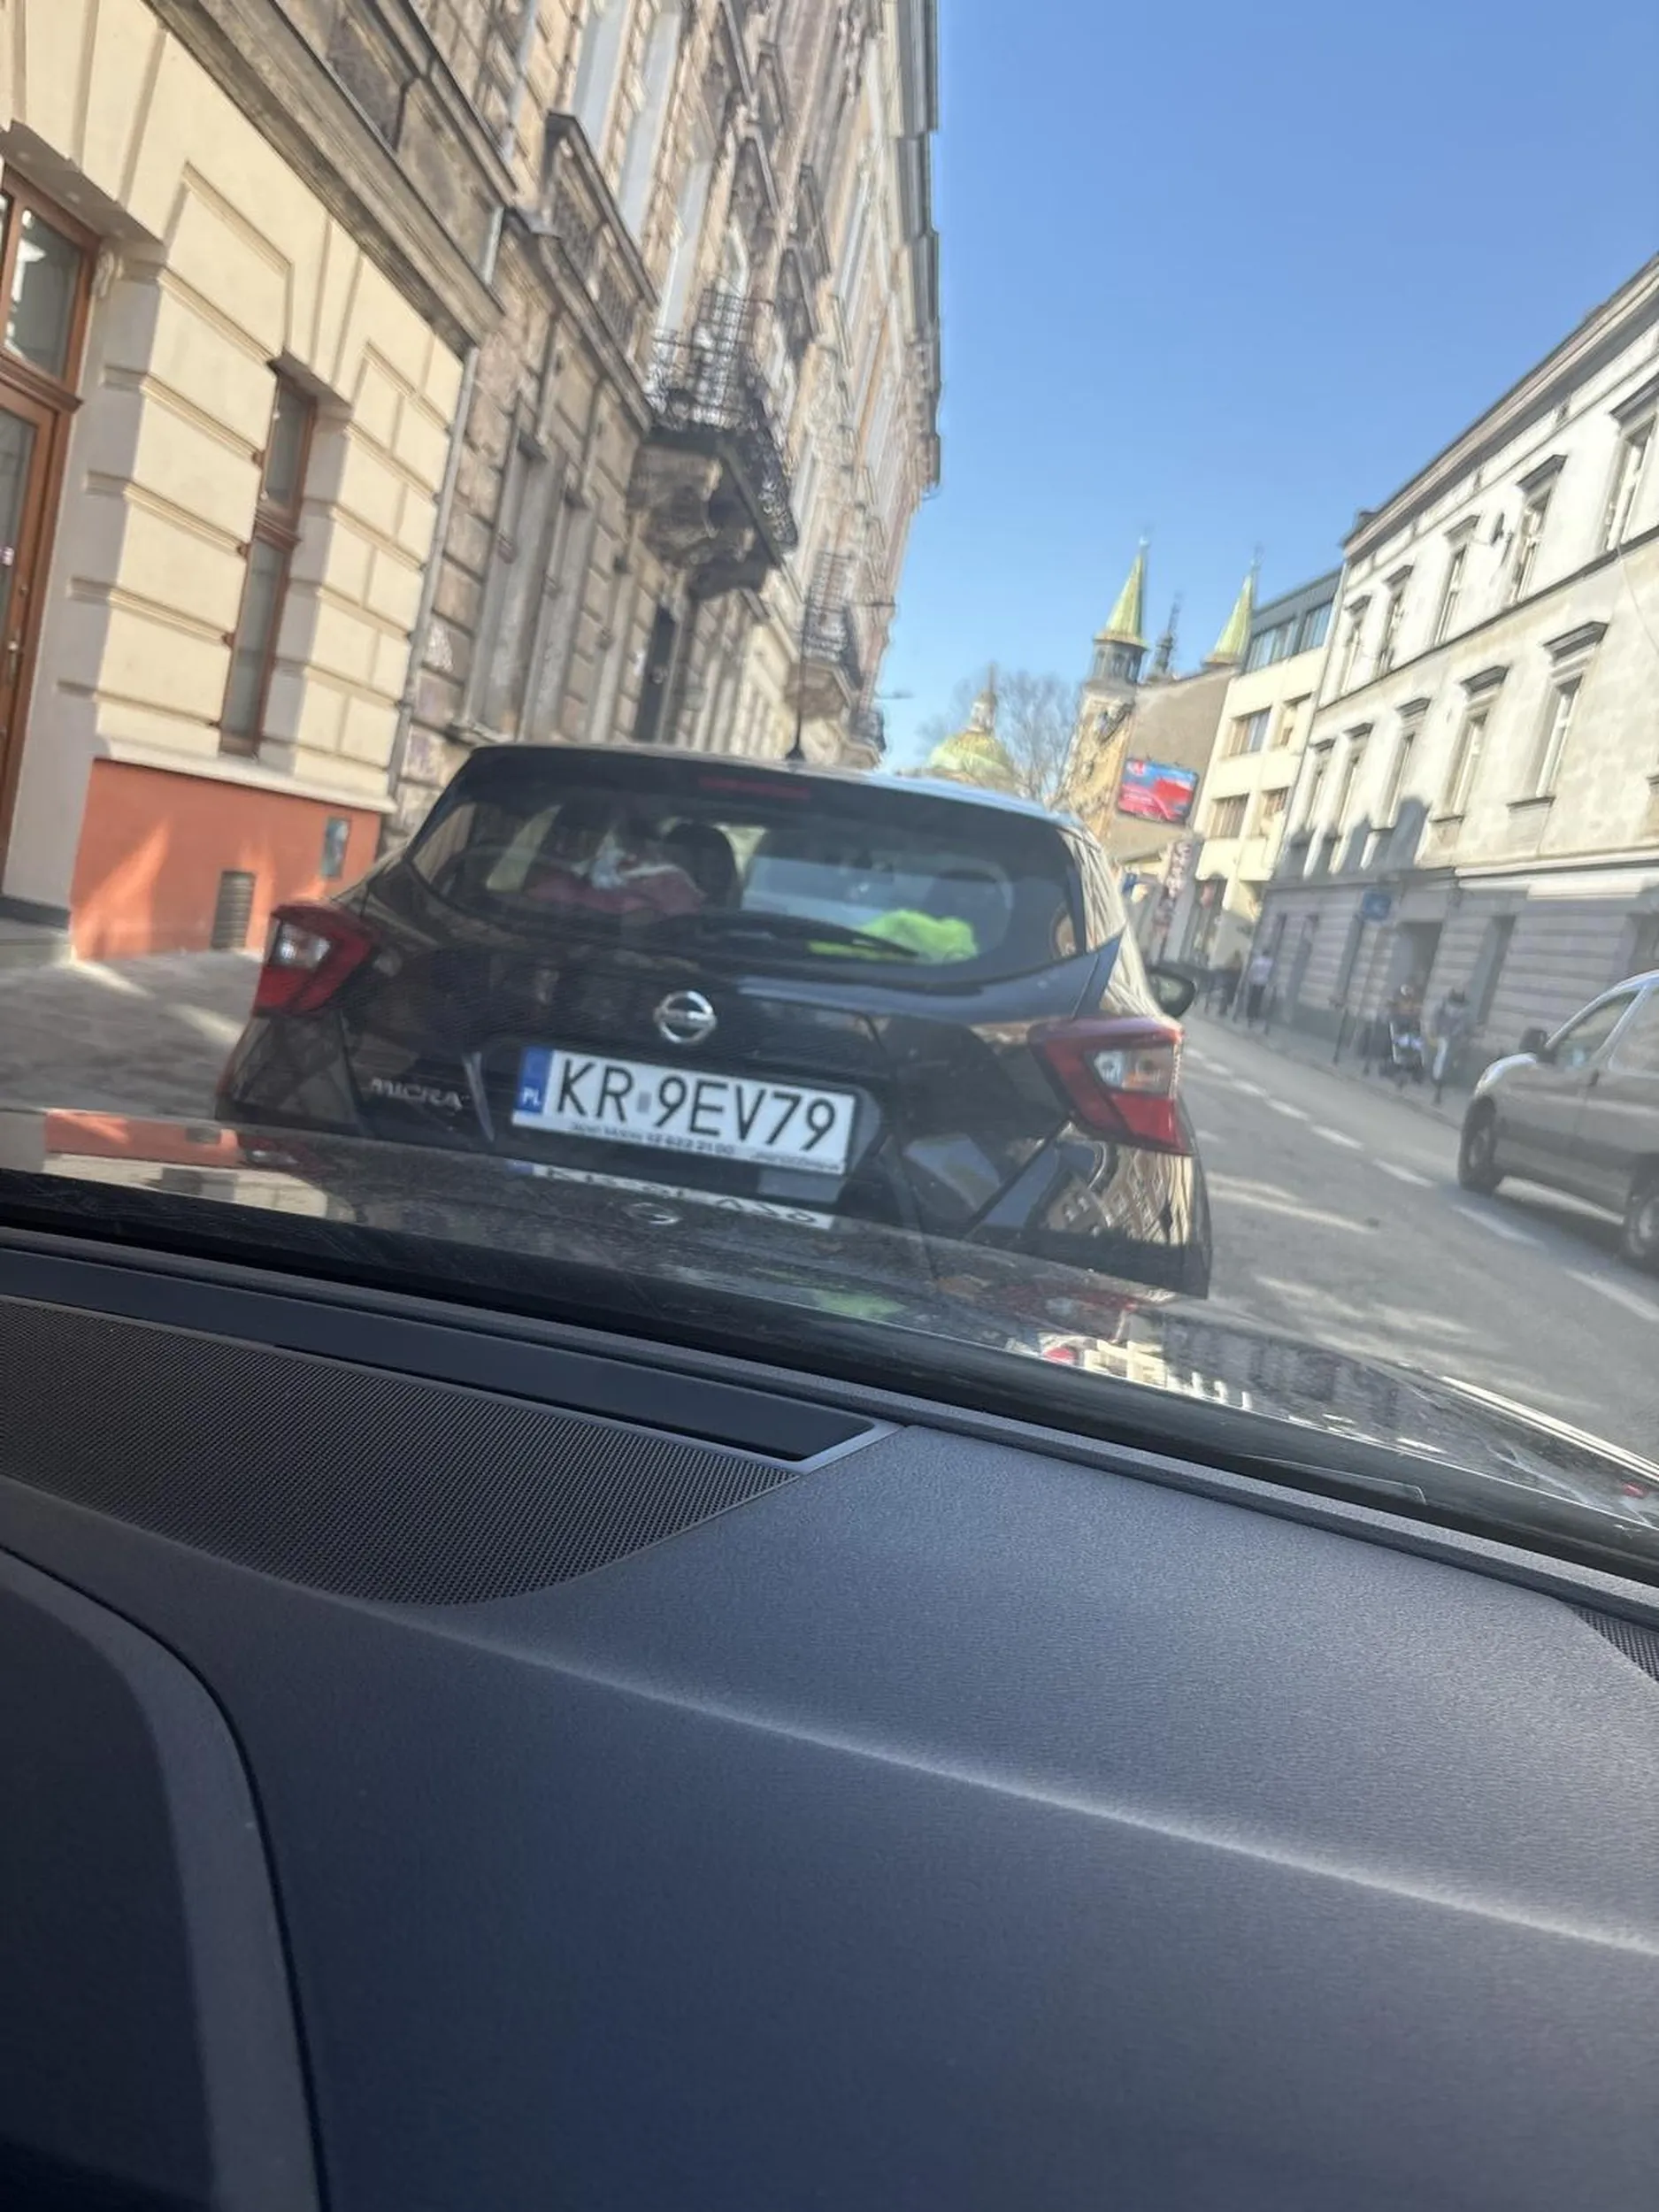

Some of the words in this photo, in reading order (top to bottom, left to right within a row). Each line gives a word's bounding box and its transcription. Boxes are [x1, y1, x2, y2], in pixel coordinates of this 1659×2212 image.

[522, 1086, 541, 1108] PL
[557, 1059, 634, 1123] KR
[654, 1075, 836, 1152] 9EV79
